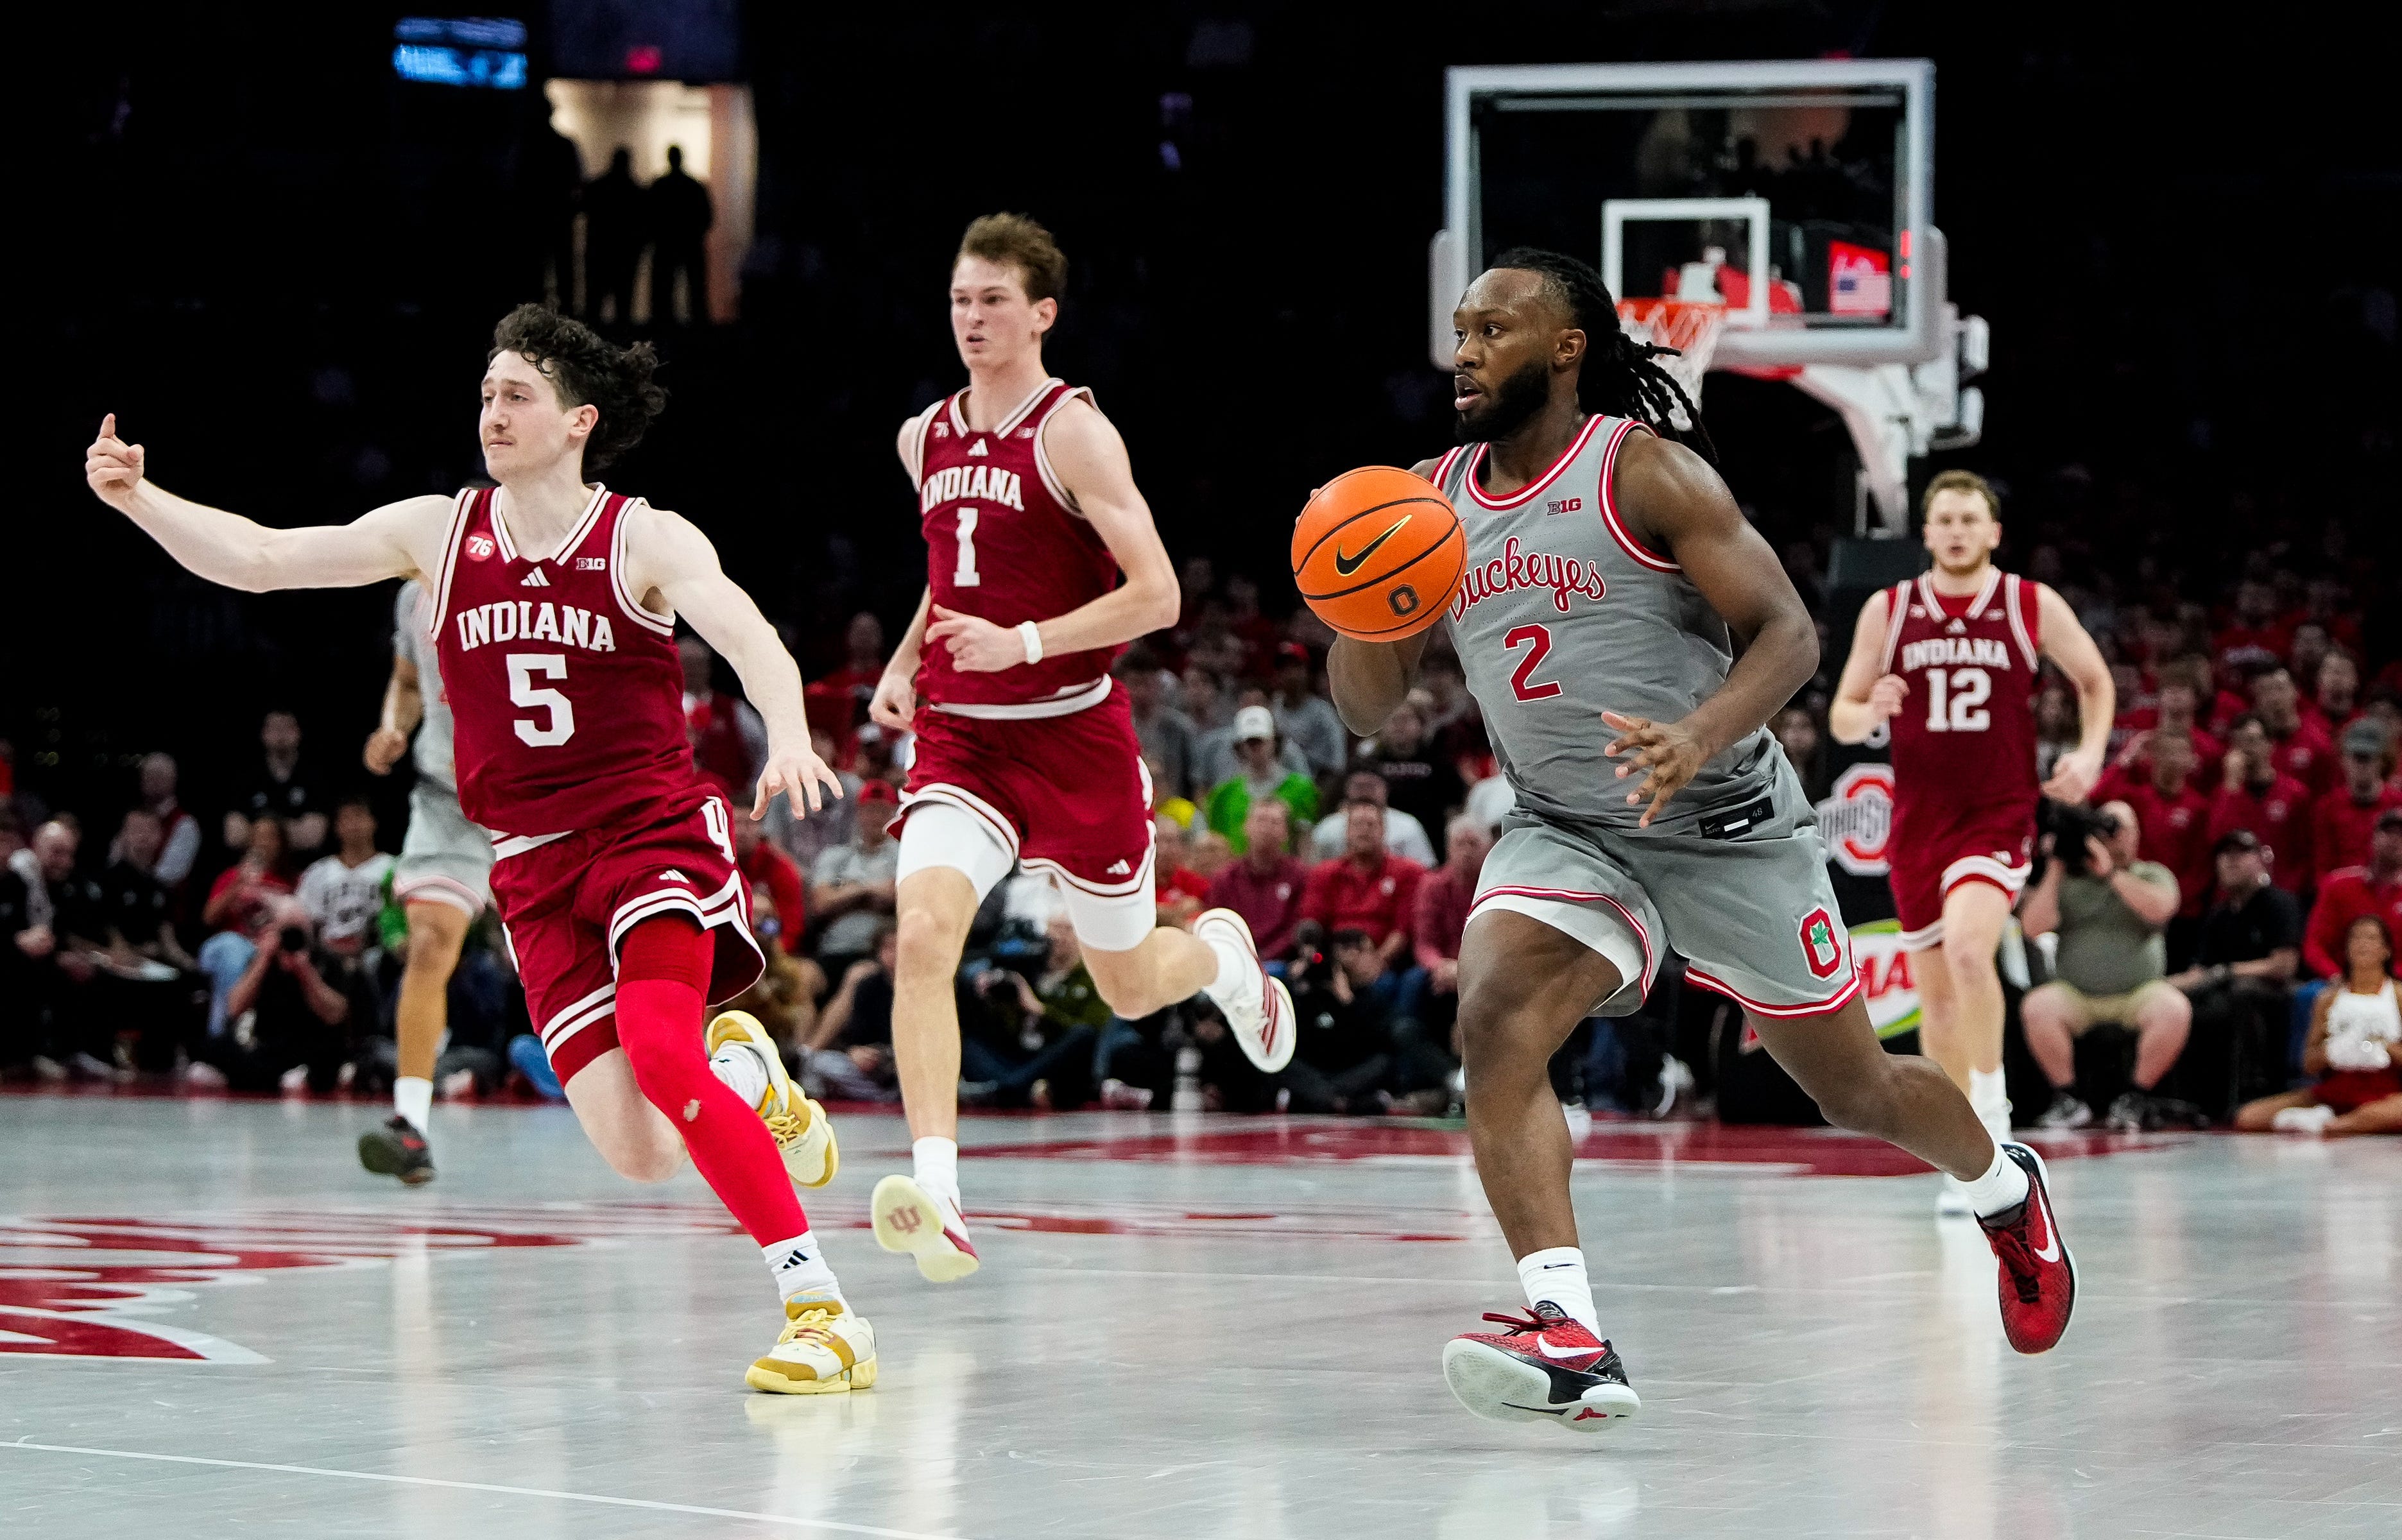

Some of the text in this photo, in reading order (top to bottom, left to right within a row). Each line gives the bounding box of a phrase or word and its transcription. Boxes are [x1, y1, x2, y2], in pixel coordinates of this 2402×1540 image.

[922, 465, 1025, 514] INDIANA
[954, 507, 980, 587] 1
[456, 601, 616, 652] INDIANA
[1901, 637, 2012, 673] INDIANA
[1503, 622, 1563, 703] 2
[506, 653, 575, 747] 5
[1925, 667, 1991, 732] 12
